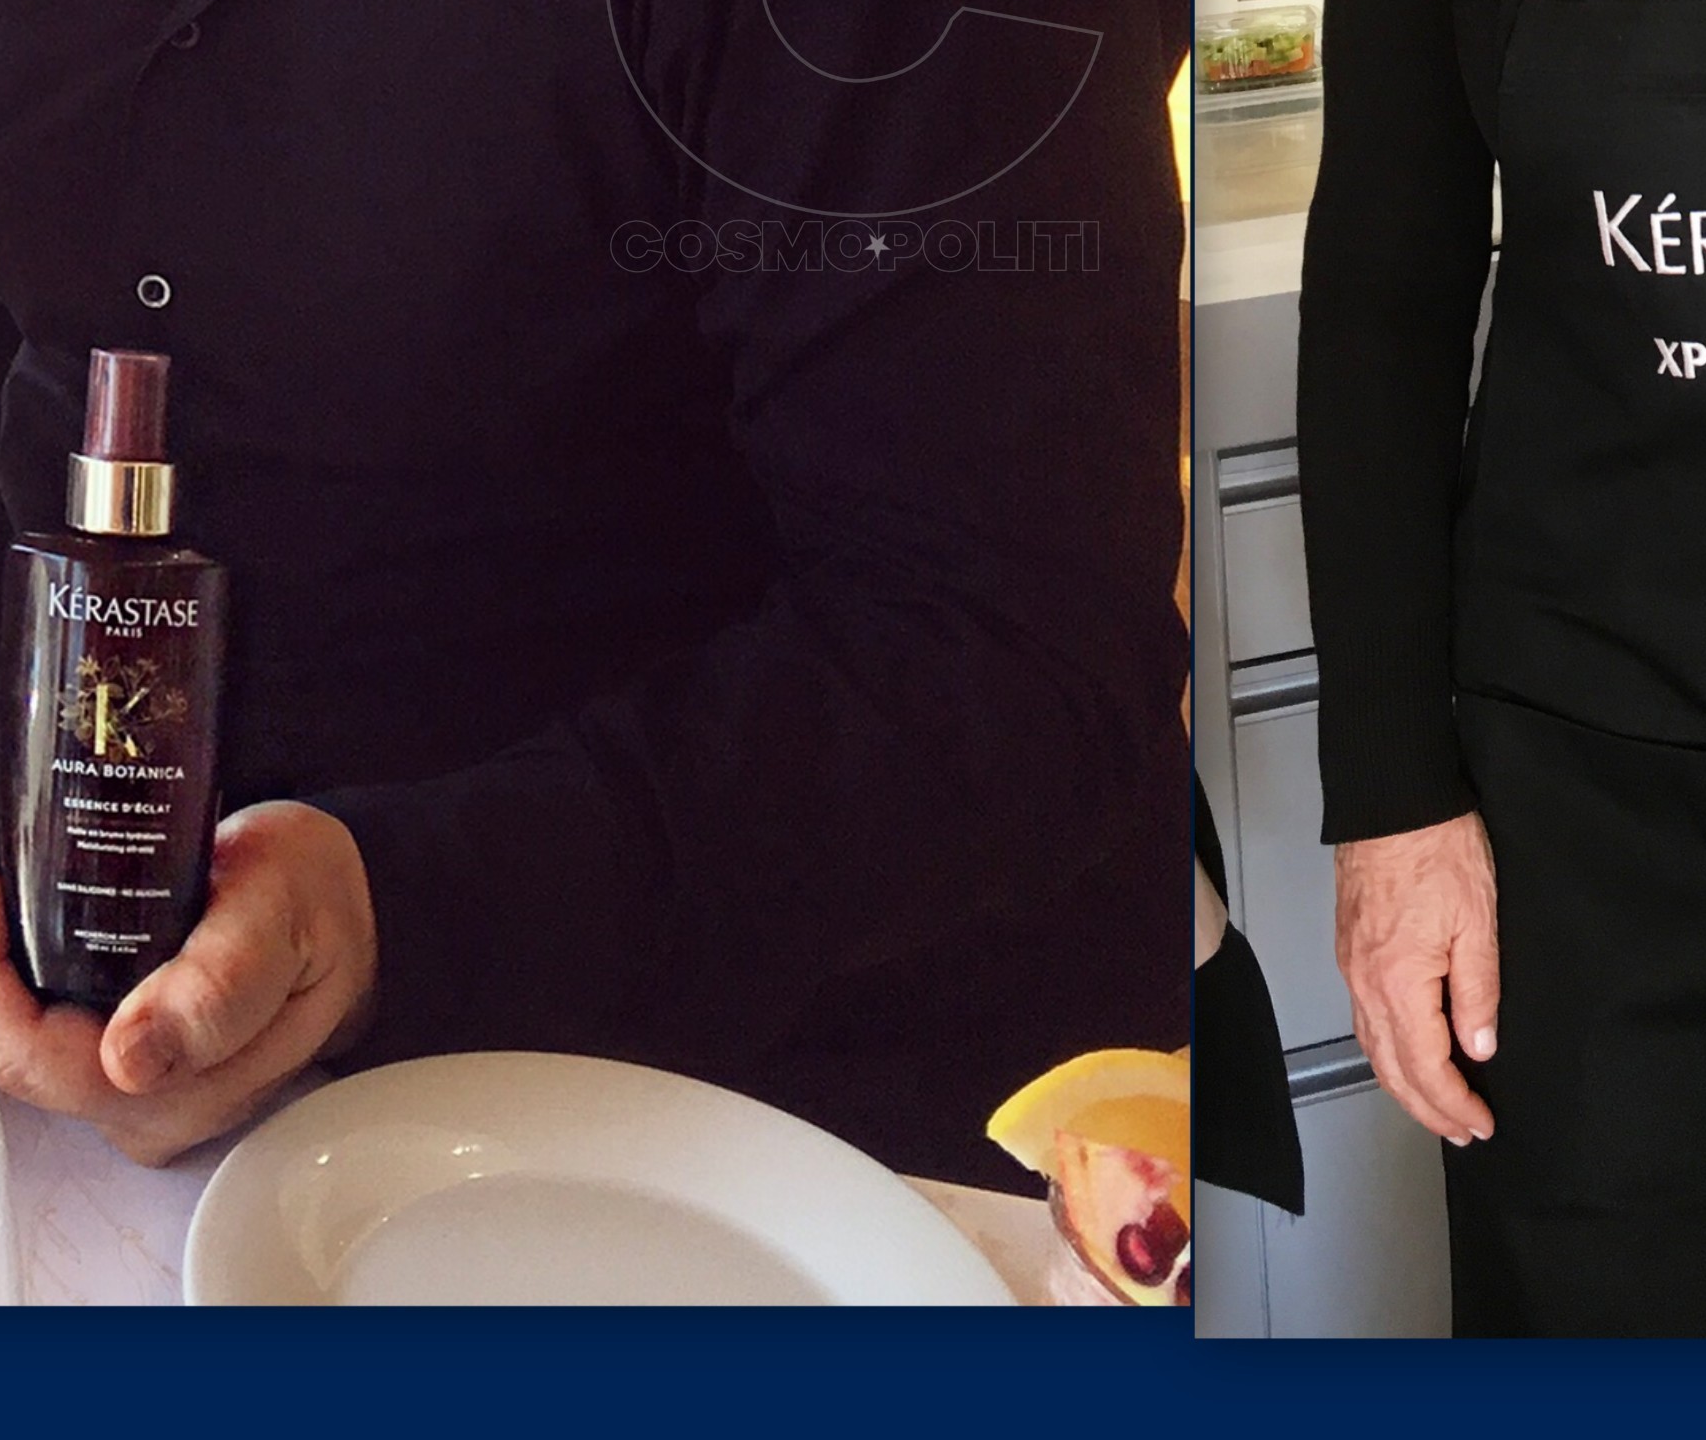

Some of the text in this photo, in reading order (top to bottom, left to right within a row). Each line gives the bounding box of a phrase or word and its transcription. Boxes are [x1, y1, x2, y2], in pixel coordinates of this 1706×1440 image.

[48, 582, 200, 627] KÉRASTASE
[105, 625, 143, 638] PARIS
[94, 684, 152, 757] K
[51, 758, 185, 780] AURA BOTANICA
[63, 796, 119, 812] ESSENCE
